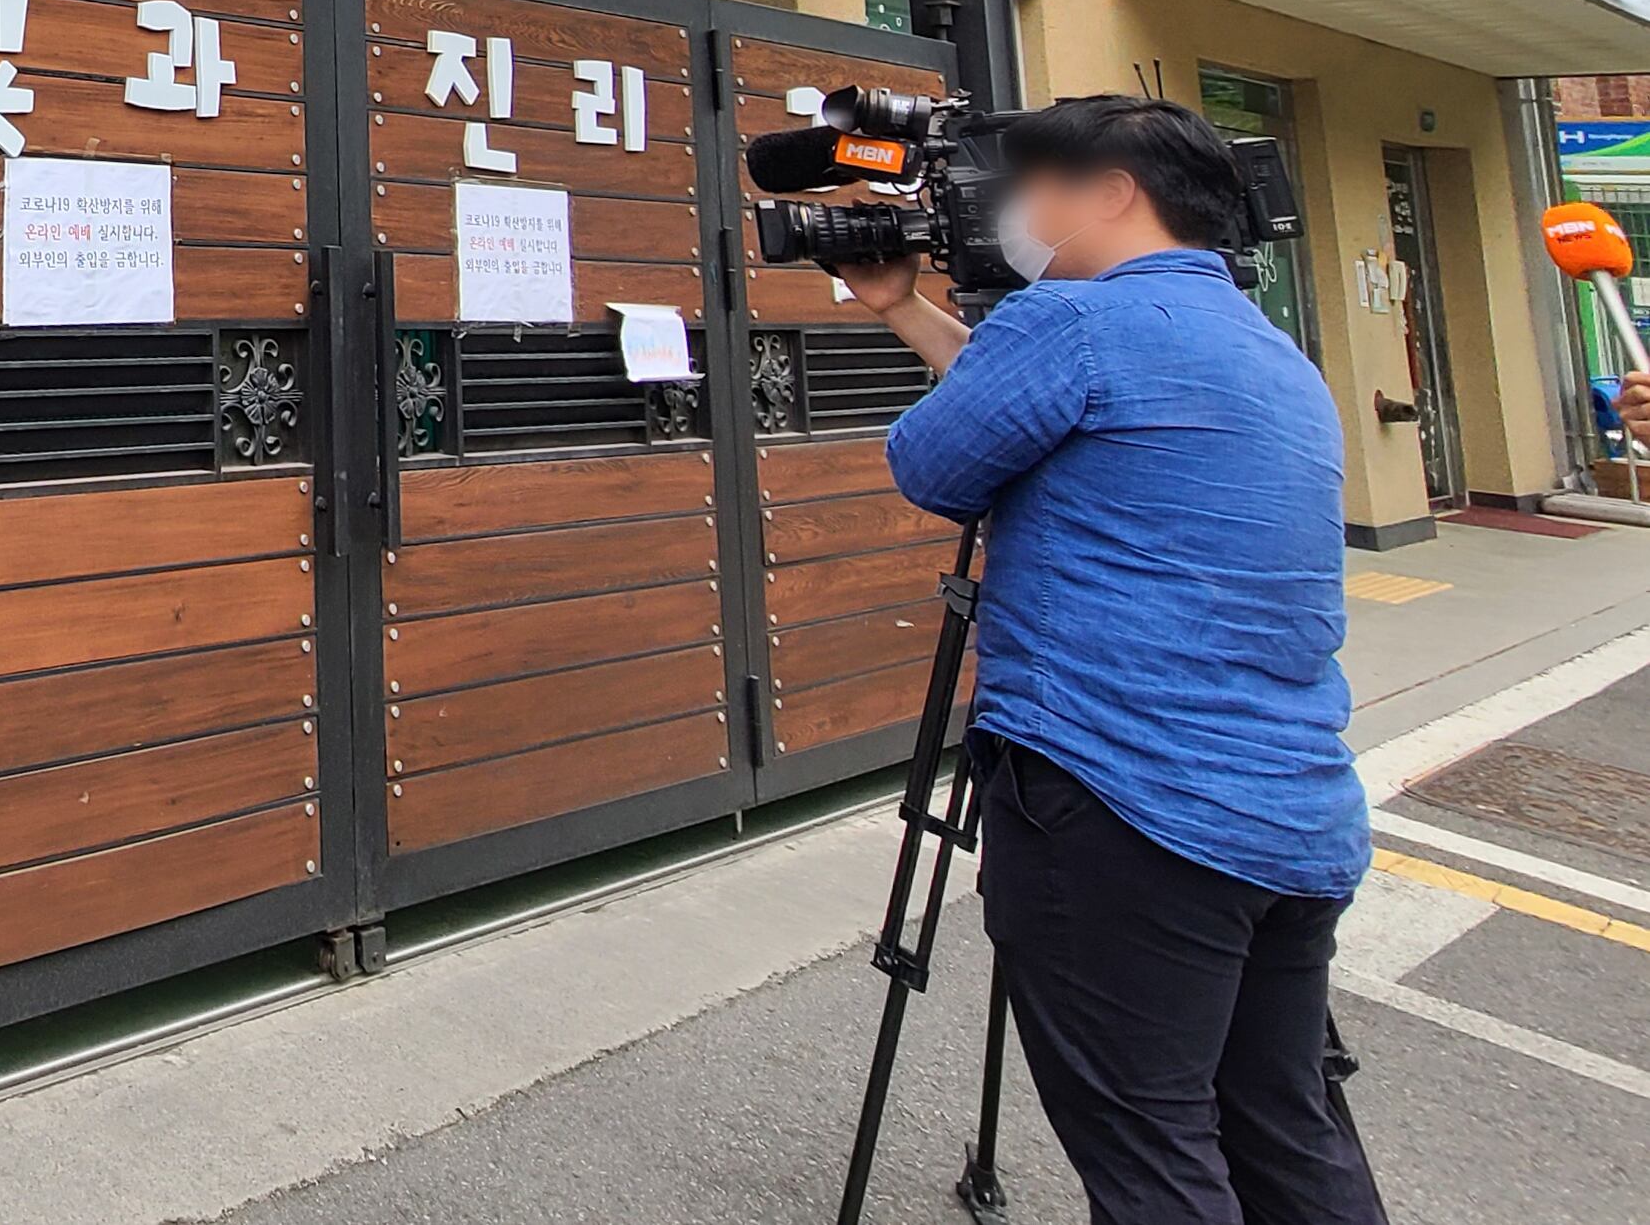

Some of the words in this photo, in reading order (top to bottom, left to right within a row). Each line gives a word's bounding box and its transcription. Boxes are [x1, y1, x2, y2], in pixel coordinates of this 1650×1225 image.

[846, 143, 893, 165] MBN
[20, 197, 70, 212] 코로나19
[77, 197, 134, 215] 확산방지를
[141, 198, 162, 215] 위해
[25, 223, 61, 241] 온라인
[68, 224, 91, 241] 예배
[98, 225, 158, 241] 실시합니다.
[1547, 221, 1596, 238] MBN
[19, 251, 68, 268] 외부인의
[75, 252, 109, 268] 출입을
[115, 252, 164, 268] 금합니다.
